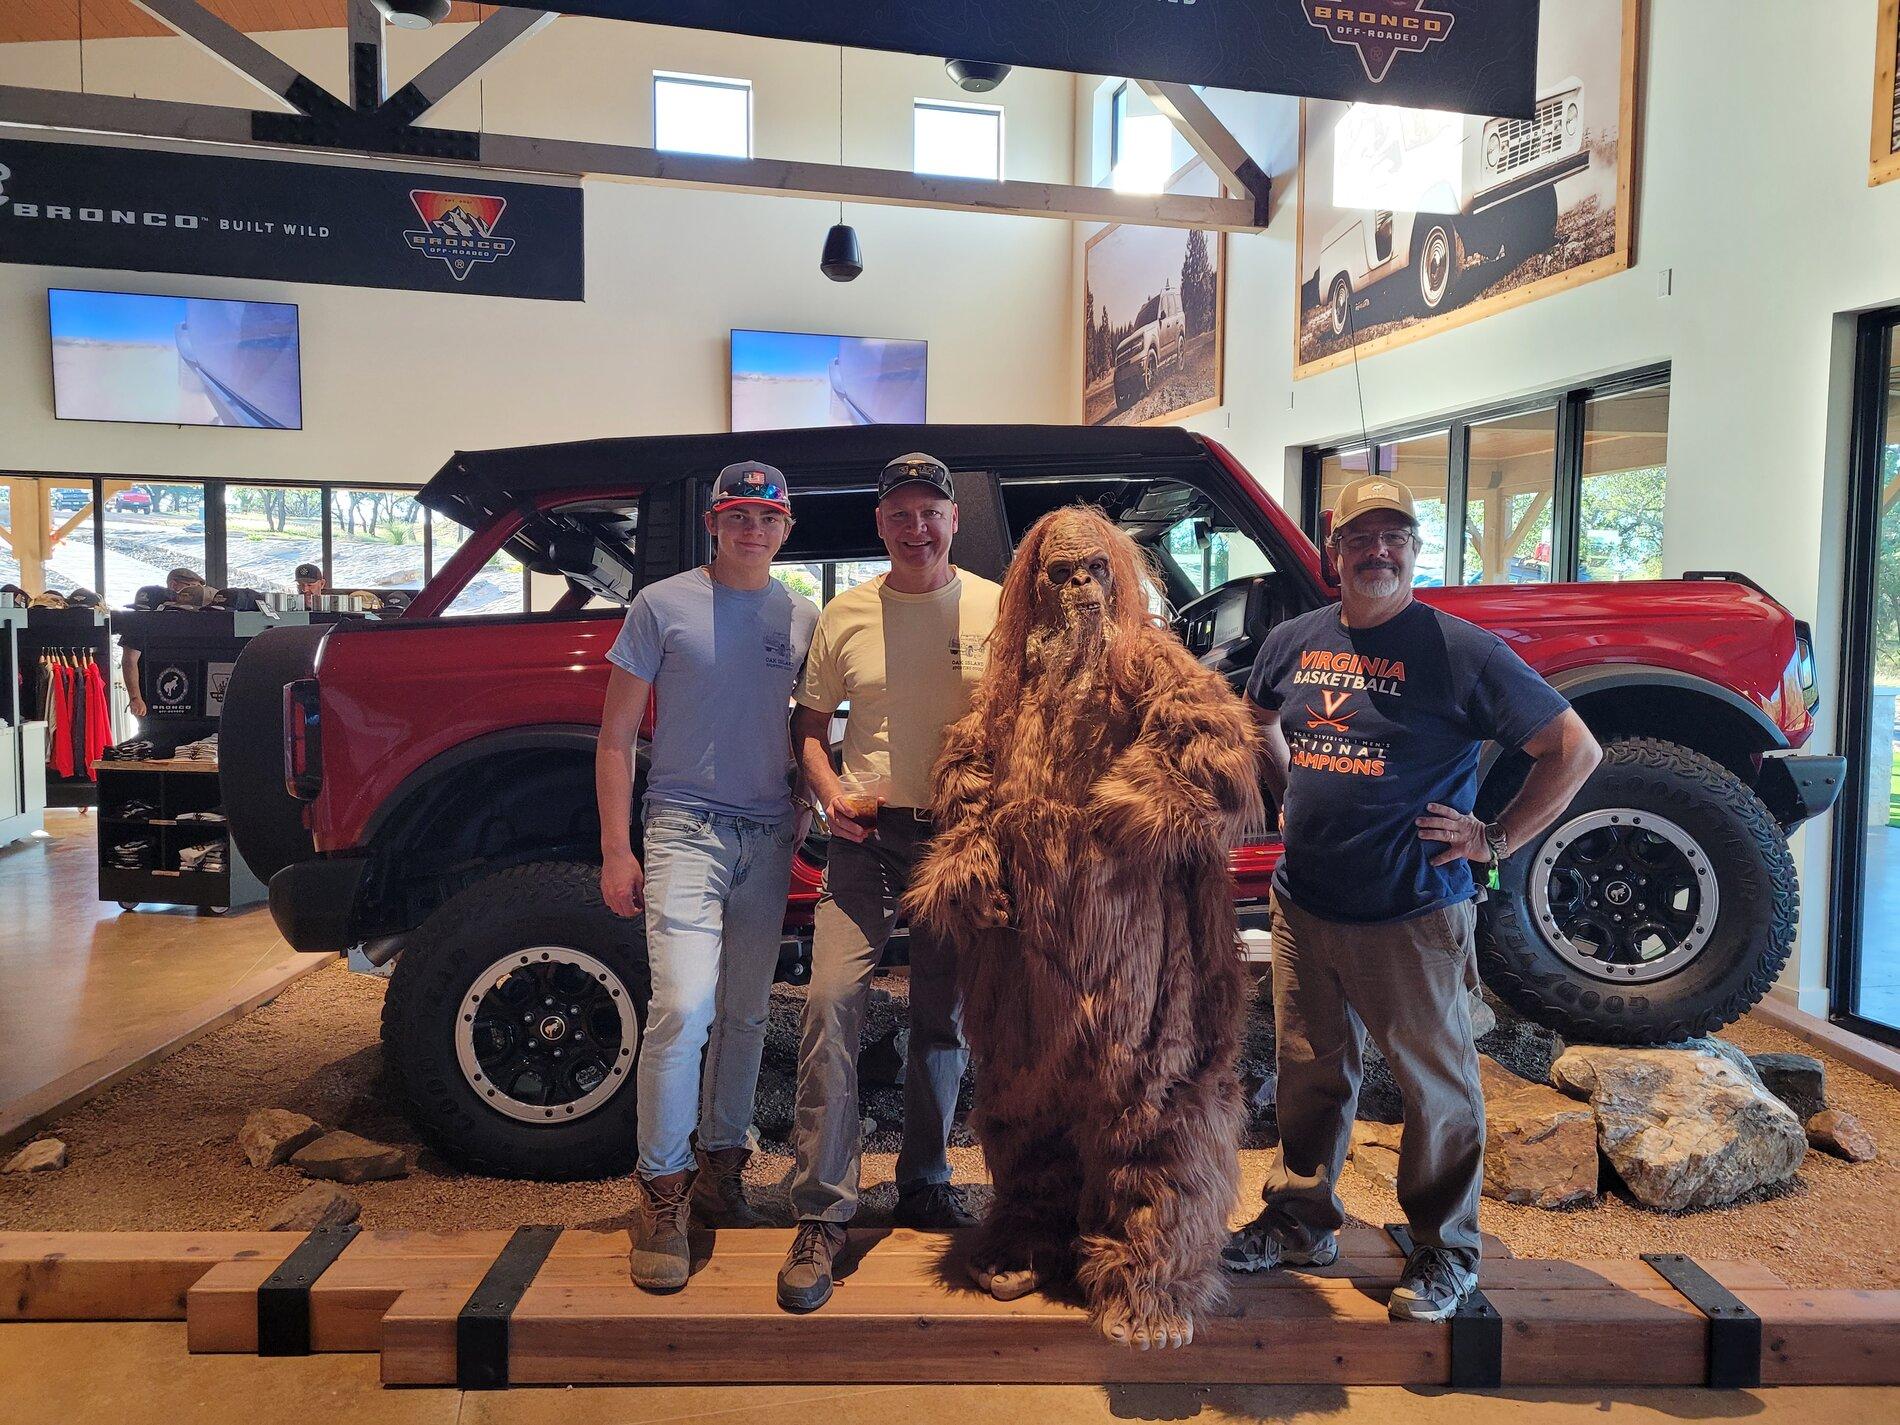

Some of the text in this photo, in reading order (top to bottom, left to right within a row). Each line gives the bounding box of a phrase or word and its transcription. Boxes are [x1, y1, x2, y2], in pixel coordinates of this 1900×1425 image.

[1314, 6, 1441, 32] BRONCO
[1337, 26, 1418, 42] OFF-ROADEO
[219, 219, 275, 234] BUILT
[283, 223, 330, 238] WILD
[413, 236, 506, 250] BRONCO
[1300, 650, 1406, 682] VIRGINIA
[1293, 670, 1402, 697] BASKETBALL
[1291, 738, 1387, 760] ATIONAL
[1292, 750, 1385, 777] AMPIONS
